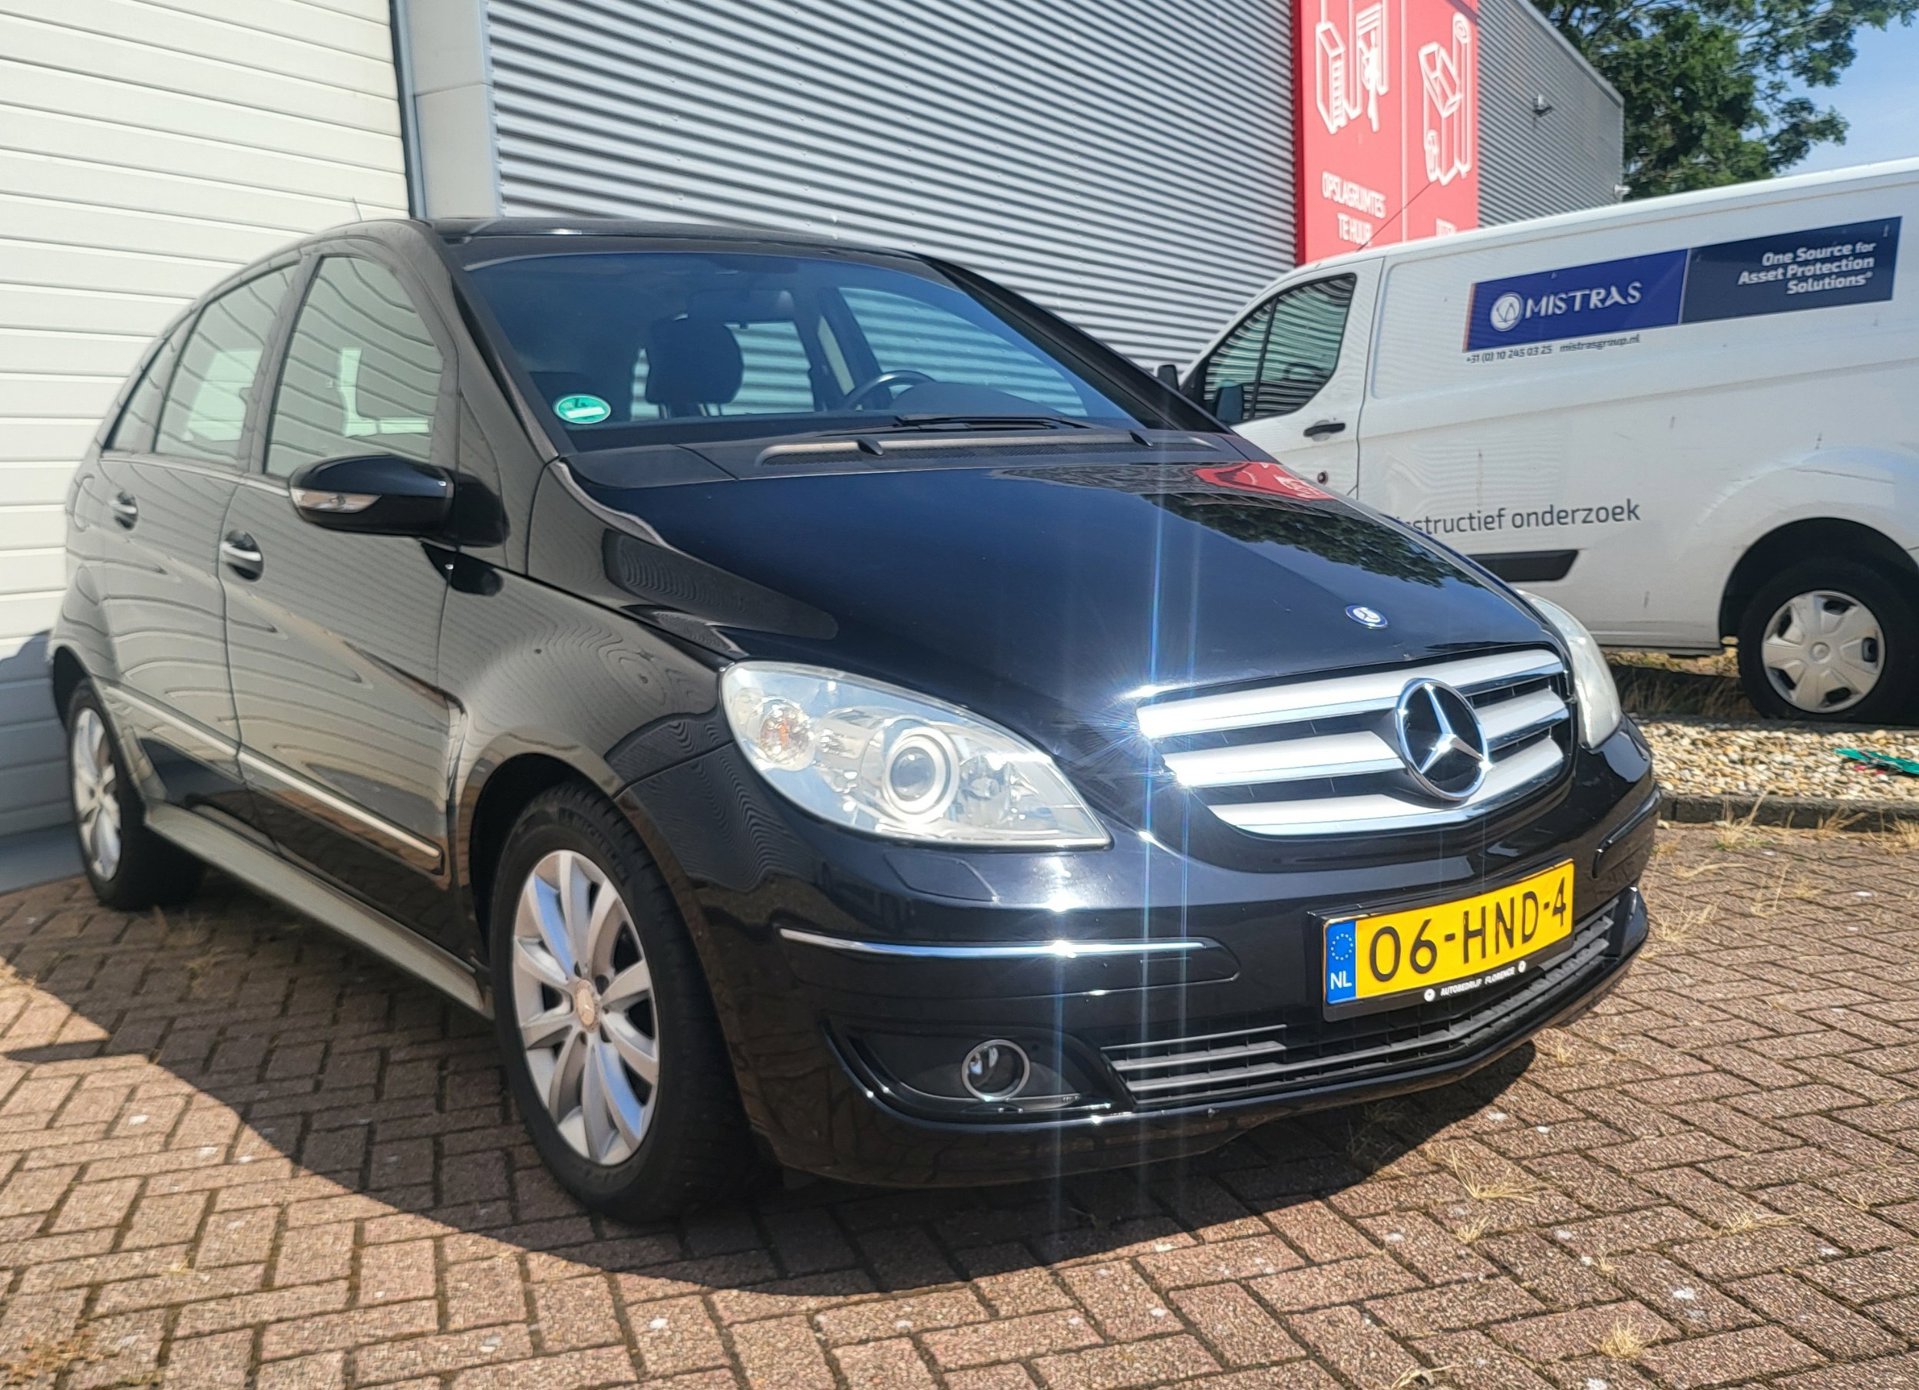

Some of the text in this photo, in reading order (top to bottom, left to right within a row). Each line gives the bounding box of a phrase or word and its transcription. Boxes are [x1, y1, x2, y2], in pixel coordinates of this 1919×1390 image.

[1336, 212, 1351, 241] TE
[1762, 241, 1877, 267] One Source for
[1737, 256, 1875, 286] Asset Protection
[1524, 281, 1642, 319] MISTRAS
[1396, 498, 1641, 535] structief onderzoek
[1330, 876, 1567, 990] NL 06-HND-4
